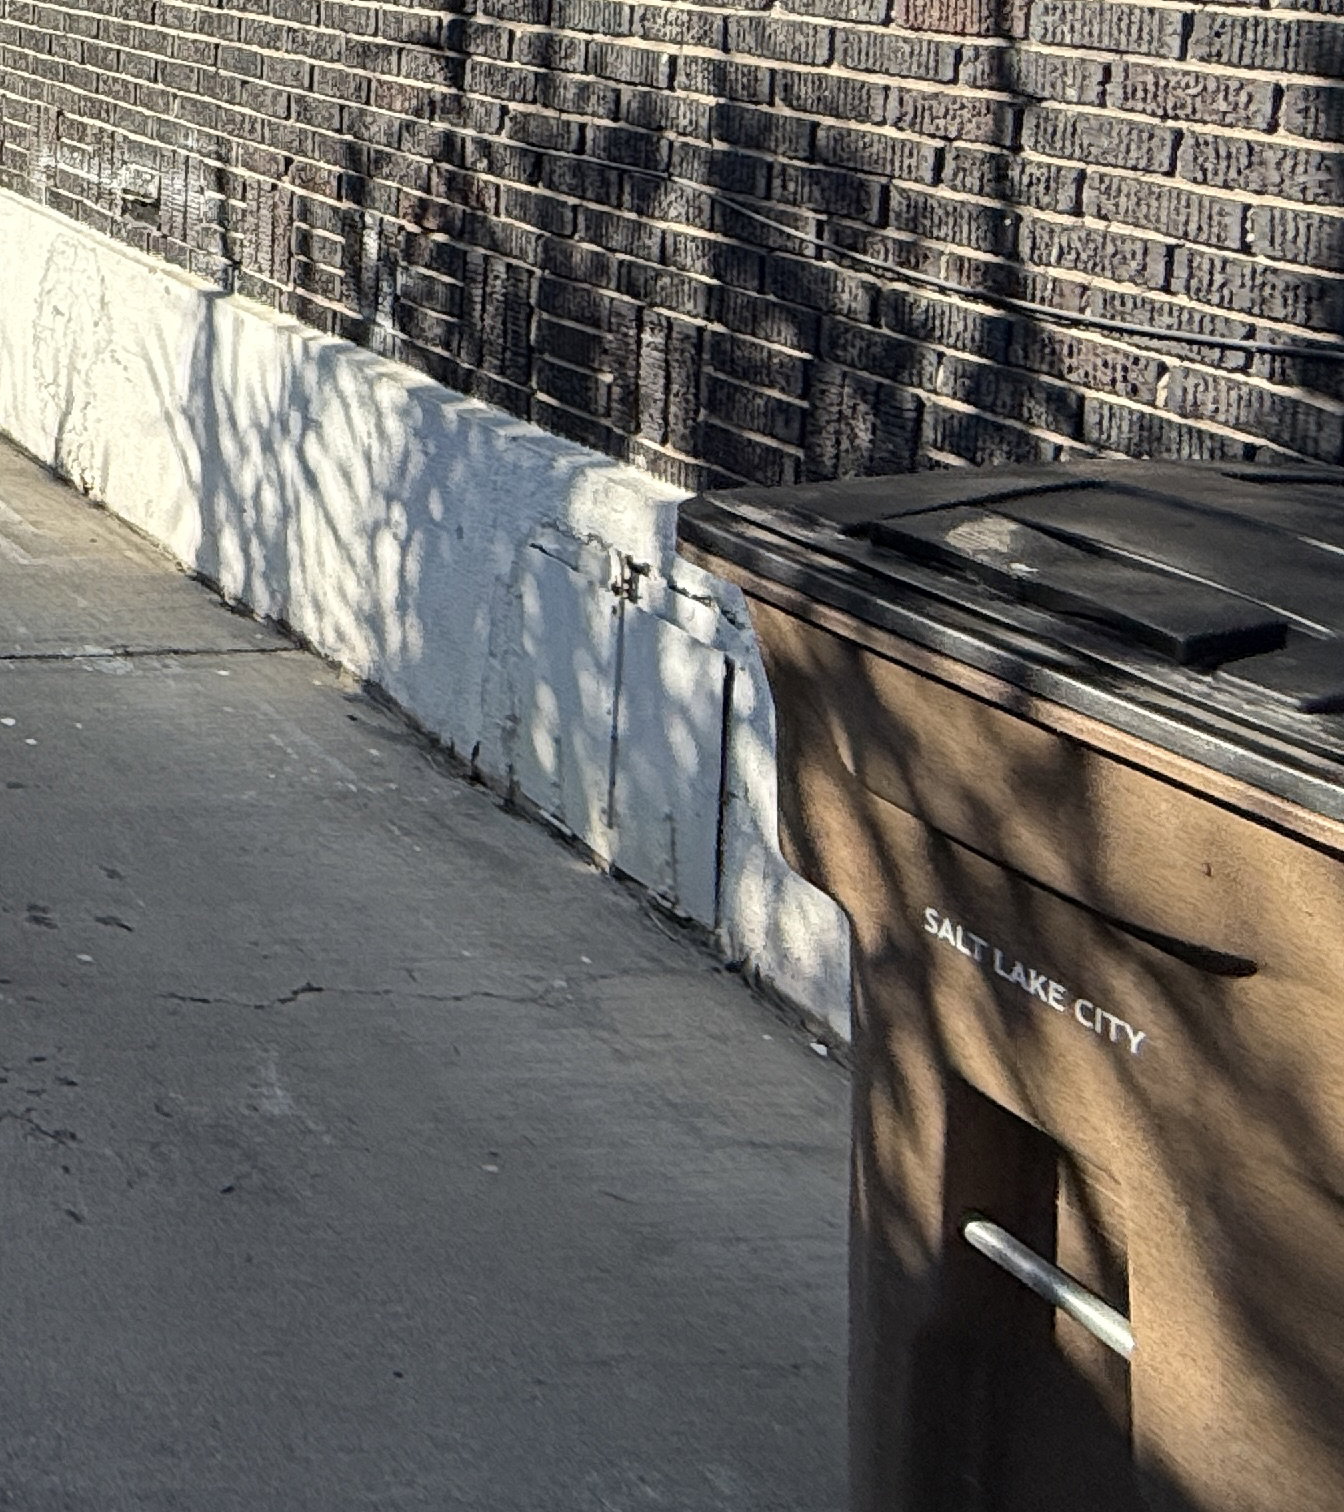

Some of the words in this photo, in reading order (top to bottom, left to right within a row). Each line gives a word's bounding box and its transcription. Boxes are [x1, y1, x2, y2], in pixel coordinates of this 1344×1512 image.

[923, 906, 989, 962] SALT
[994, 948, 1067, 1013] LAKE
[1075, 998, 1146, 1054] CITY
